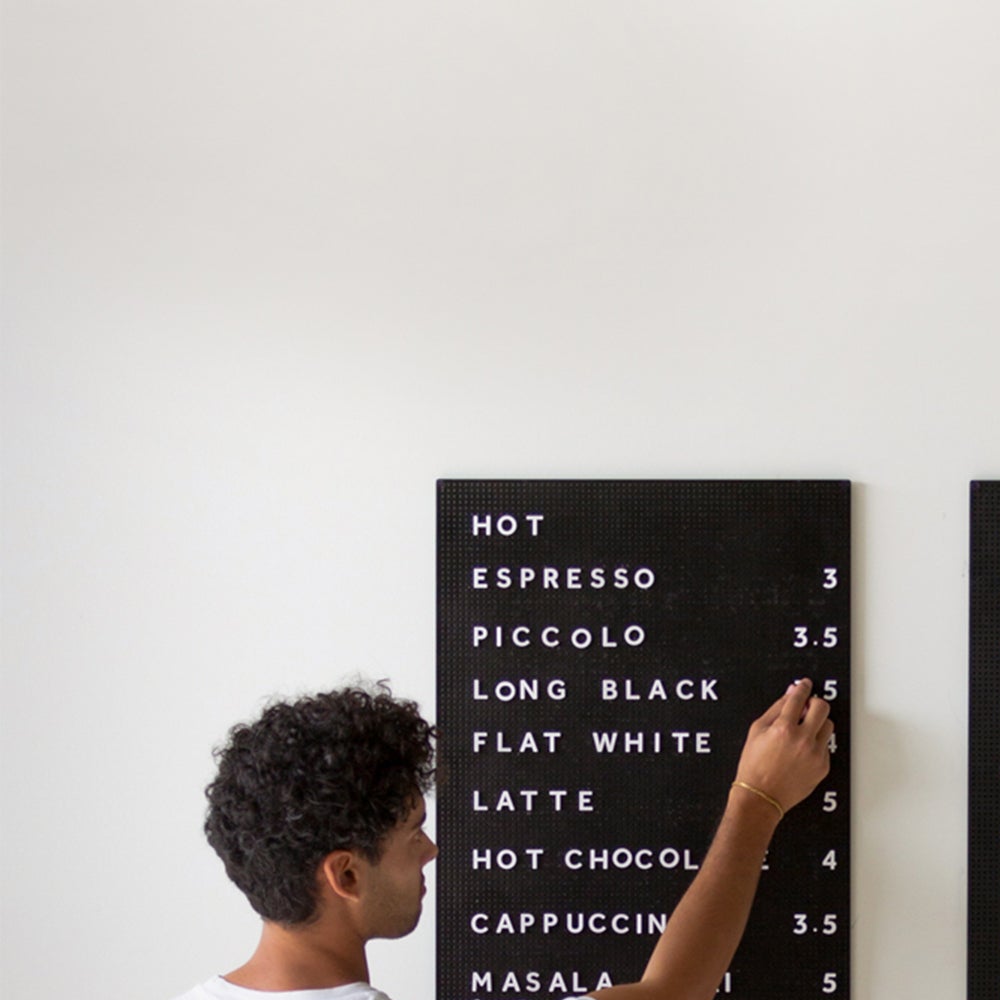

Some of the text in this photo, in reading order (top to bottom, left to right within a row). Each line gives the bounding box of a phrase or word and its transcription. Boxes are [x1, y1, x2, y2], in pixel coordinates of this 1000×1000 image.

[472, 514, 545, 537] HOT
[472, 567, 838, 590] ESPRESSO 3
[473, 624, 838, 649] PICCOLO 3.5
[473, 678, 566, 702] LONG
[601, 678, 718, 701] BLACK
[473, 731, 562, 753] FLAT
[592, 731, 711, 754] WHITE
[473, 790, 838, 812] LATTE 5
[472, 847, 838, 871] HOT CHOCOL 4
[470, 912, 838, 935] CAPPUCCIN 3.5
[471, 971, 838, 994] MASALA 5
